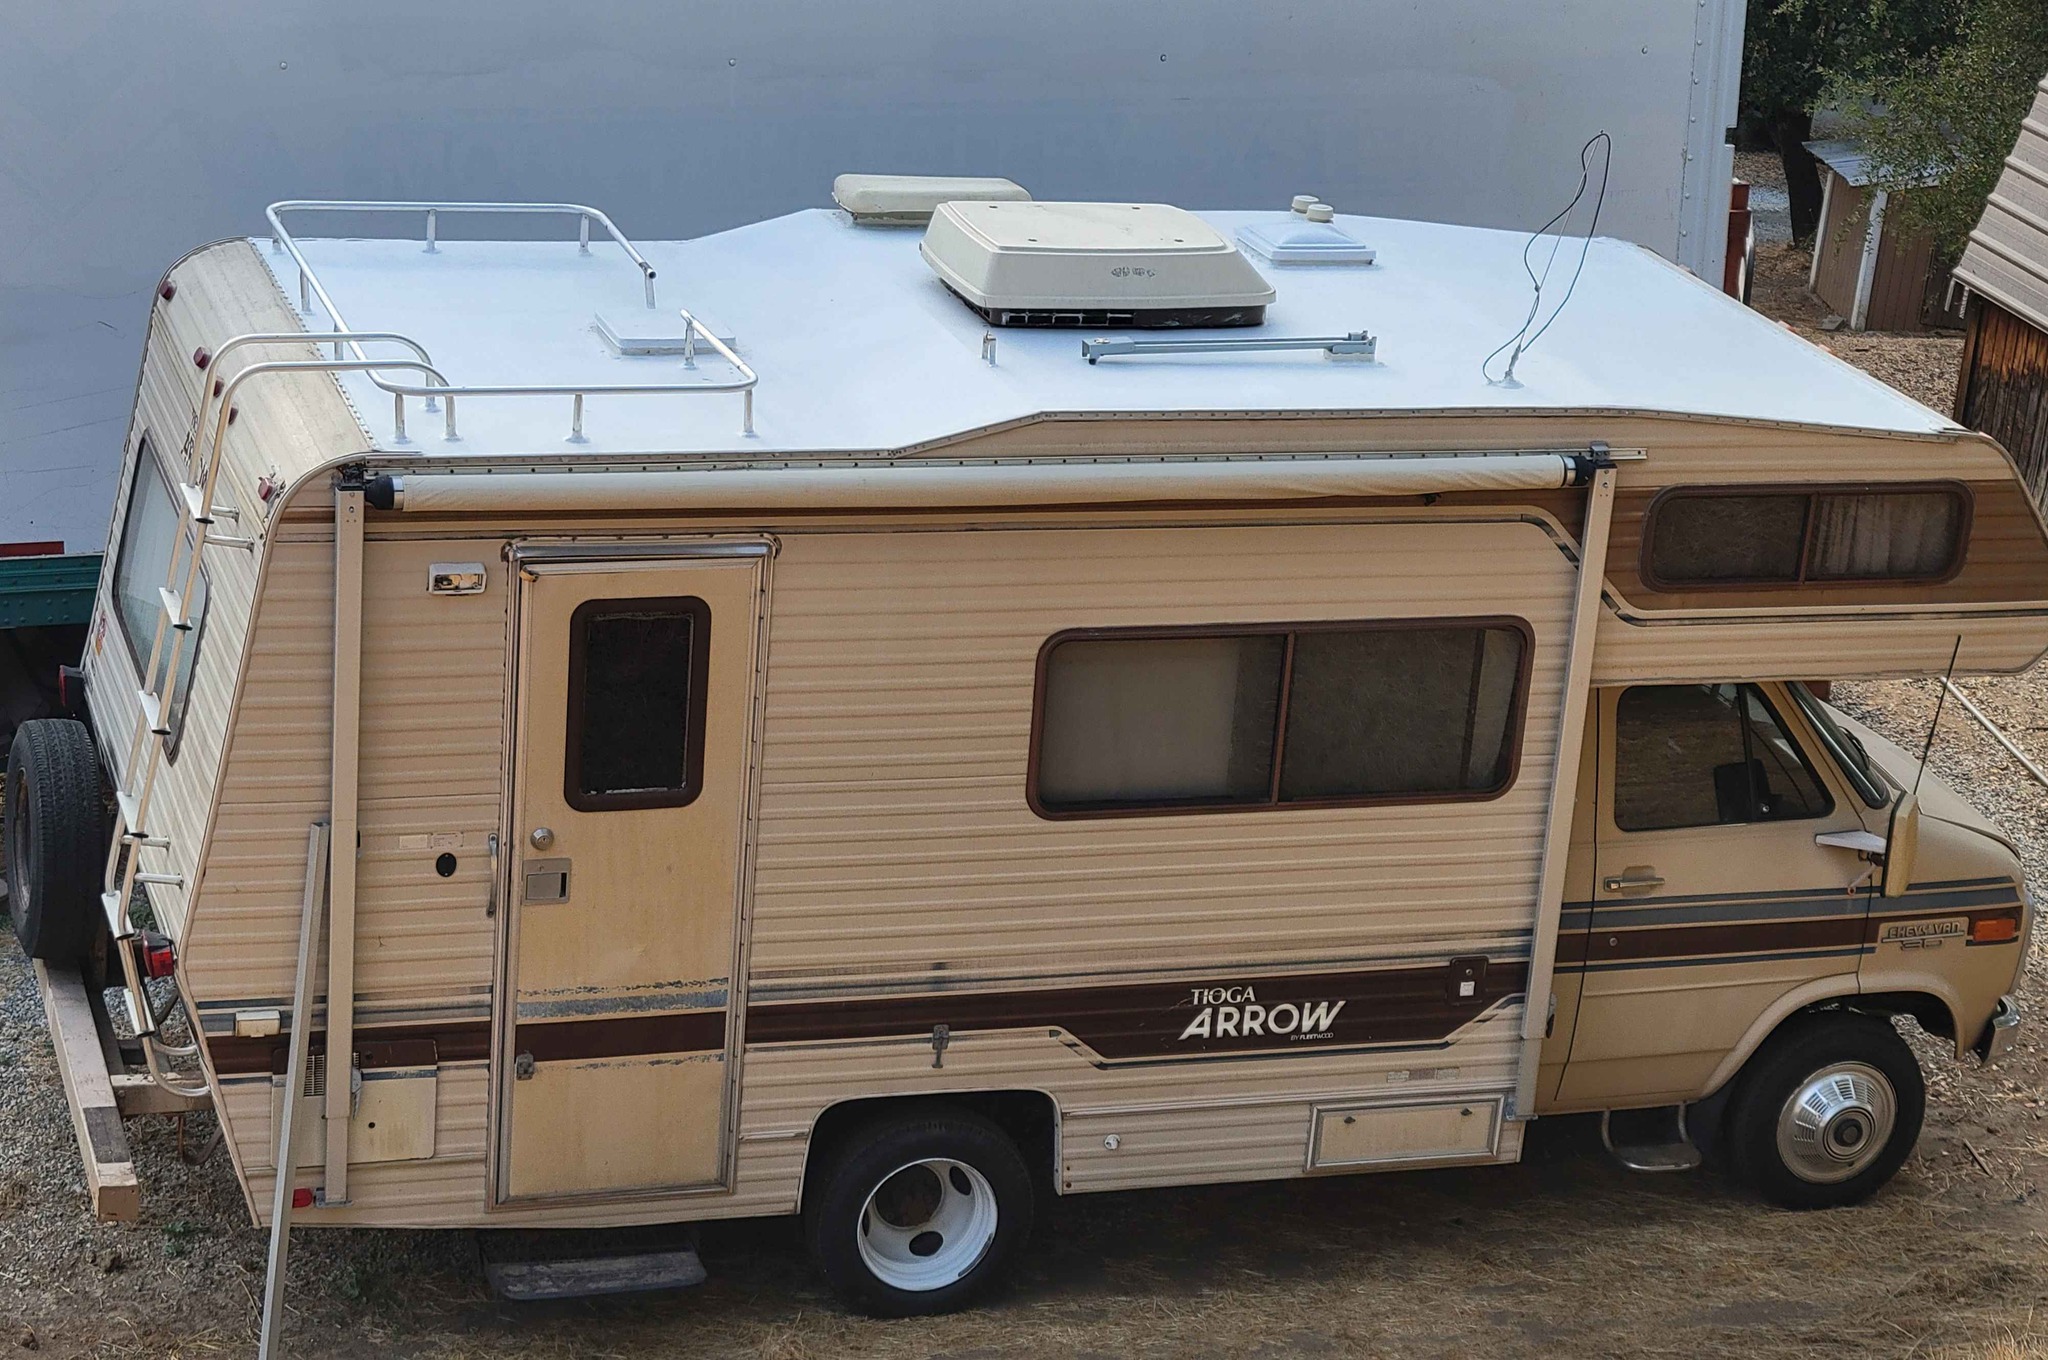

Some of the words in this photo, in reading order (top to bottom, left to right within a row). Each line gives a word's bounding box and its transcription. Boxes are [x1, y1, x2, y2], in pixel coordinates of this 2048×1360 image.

[1933, 921, 1961, 935] VAN
[1191, 986, 1256, 1005] TIOGA
[1178, 1000, 1346, 1041] ARROW
